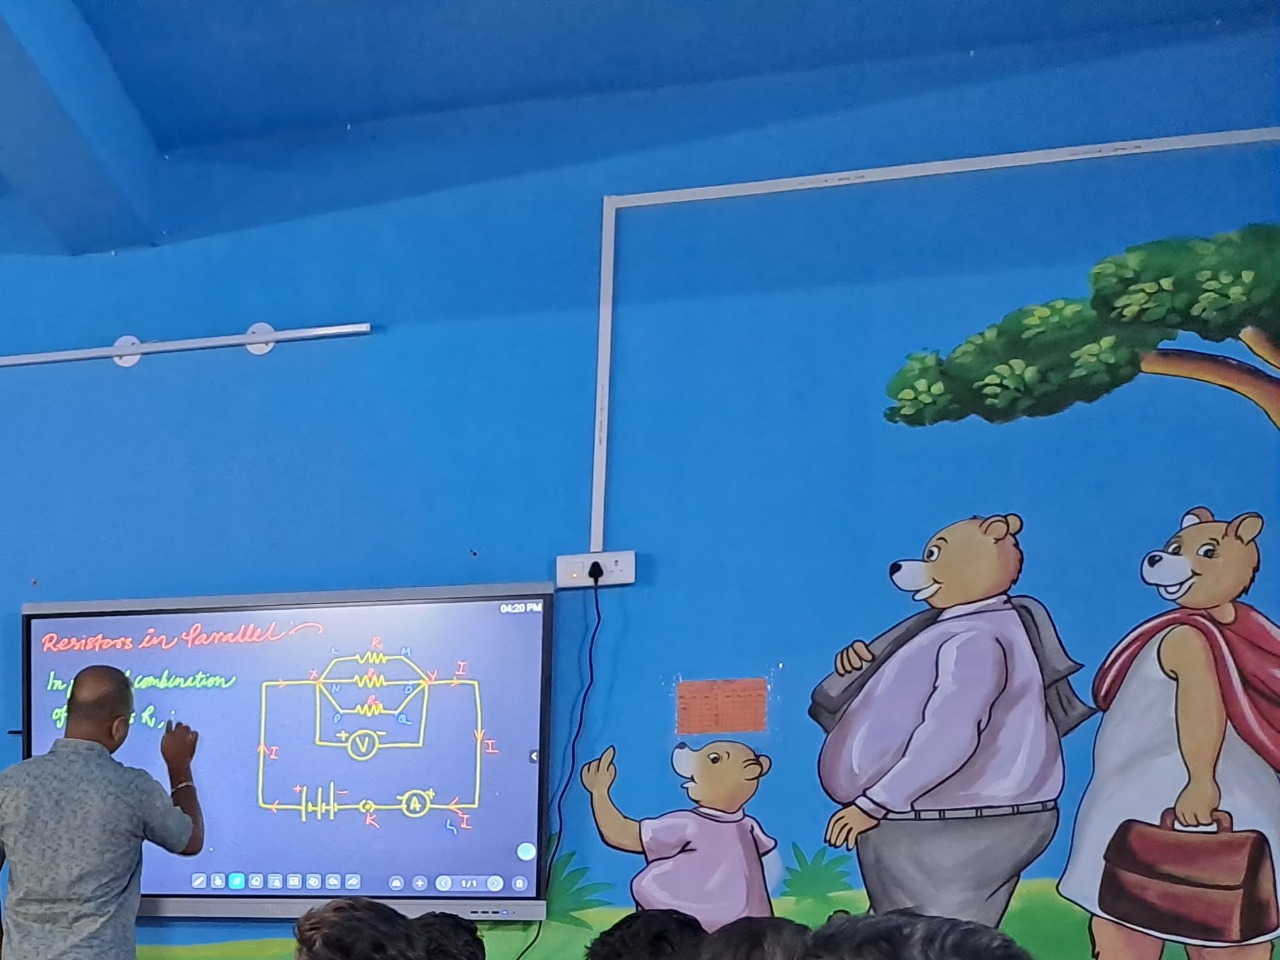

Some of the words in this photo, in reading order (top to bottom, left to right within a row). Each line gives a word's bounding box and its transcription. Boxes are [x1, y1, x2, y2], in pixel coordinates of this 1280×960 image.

[500, 603, 525, 613] 04:20
[526, 602, 542, 612] PM
[42, 632, 133, 652] Resistors
[139, 628, 177, 650] in
[182, 621, 289, 648] Parallel
[47, 669, 66, 691] In
[134, 669, 237, 689] combination
[355, 736, 369, 753] V
[409, 796, 421, 811] A
[366, 813, 380, 828] K
[460, 879, 477, 888] 1/1
